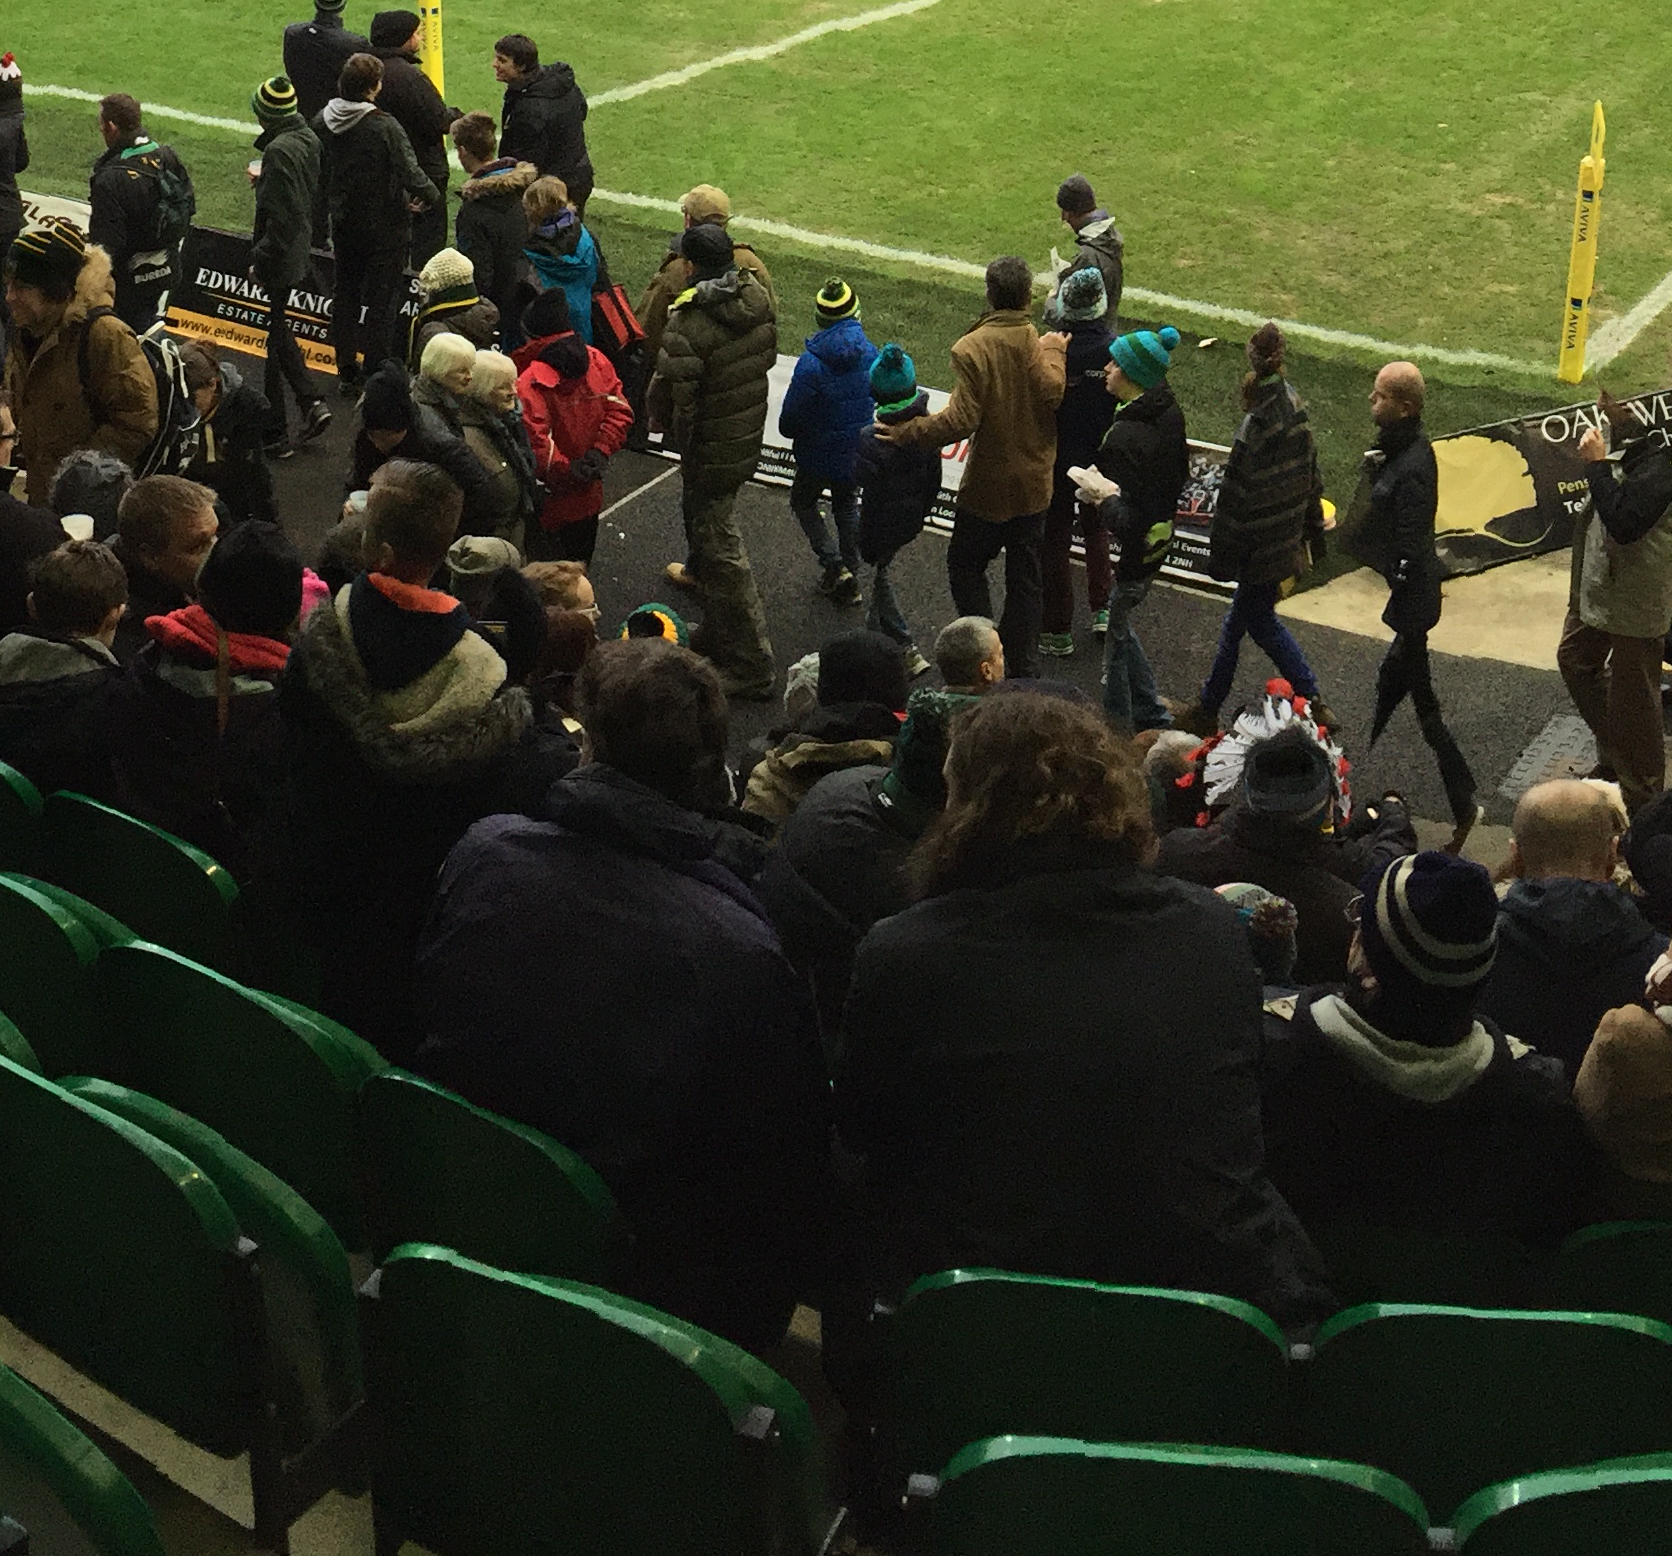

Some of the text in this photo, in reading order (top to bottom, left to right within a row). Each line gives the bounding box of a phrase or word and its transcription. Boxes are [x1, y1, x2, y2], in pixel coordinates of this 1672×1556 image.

[1578, 206, 1590, 243] AVIVA
[217, 303, 328, 339] ESTATE ENTS
[1566, 313, 1579, 350] AVIVA
[1181, 542, 1212, 557] Events
